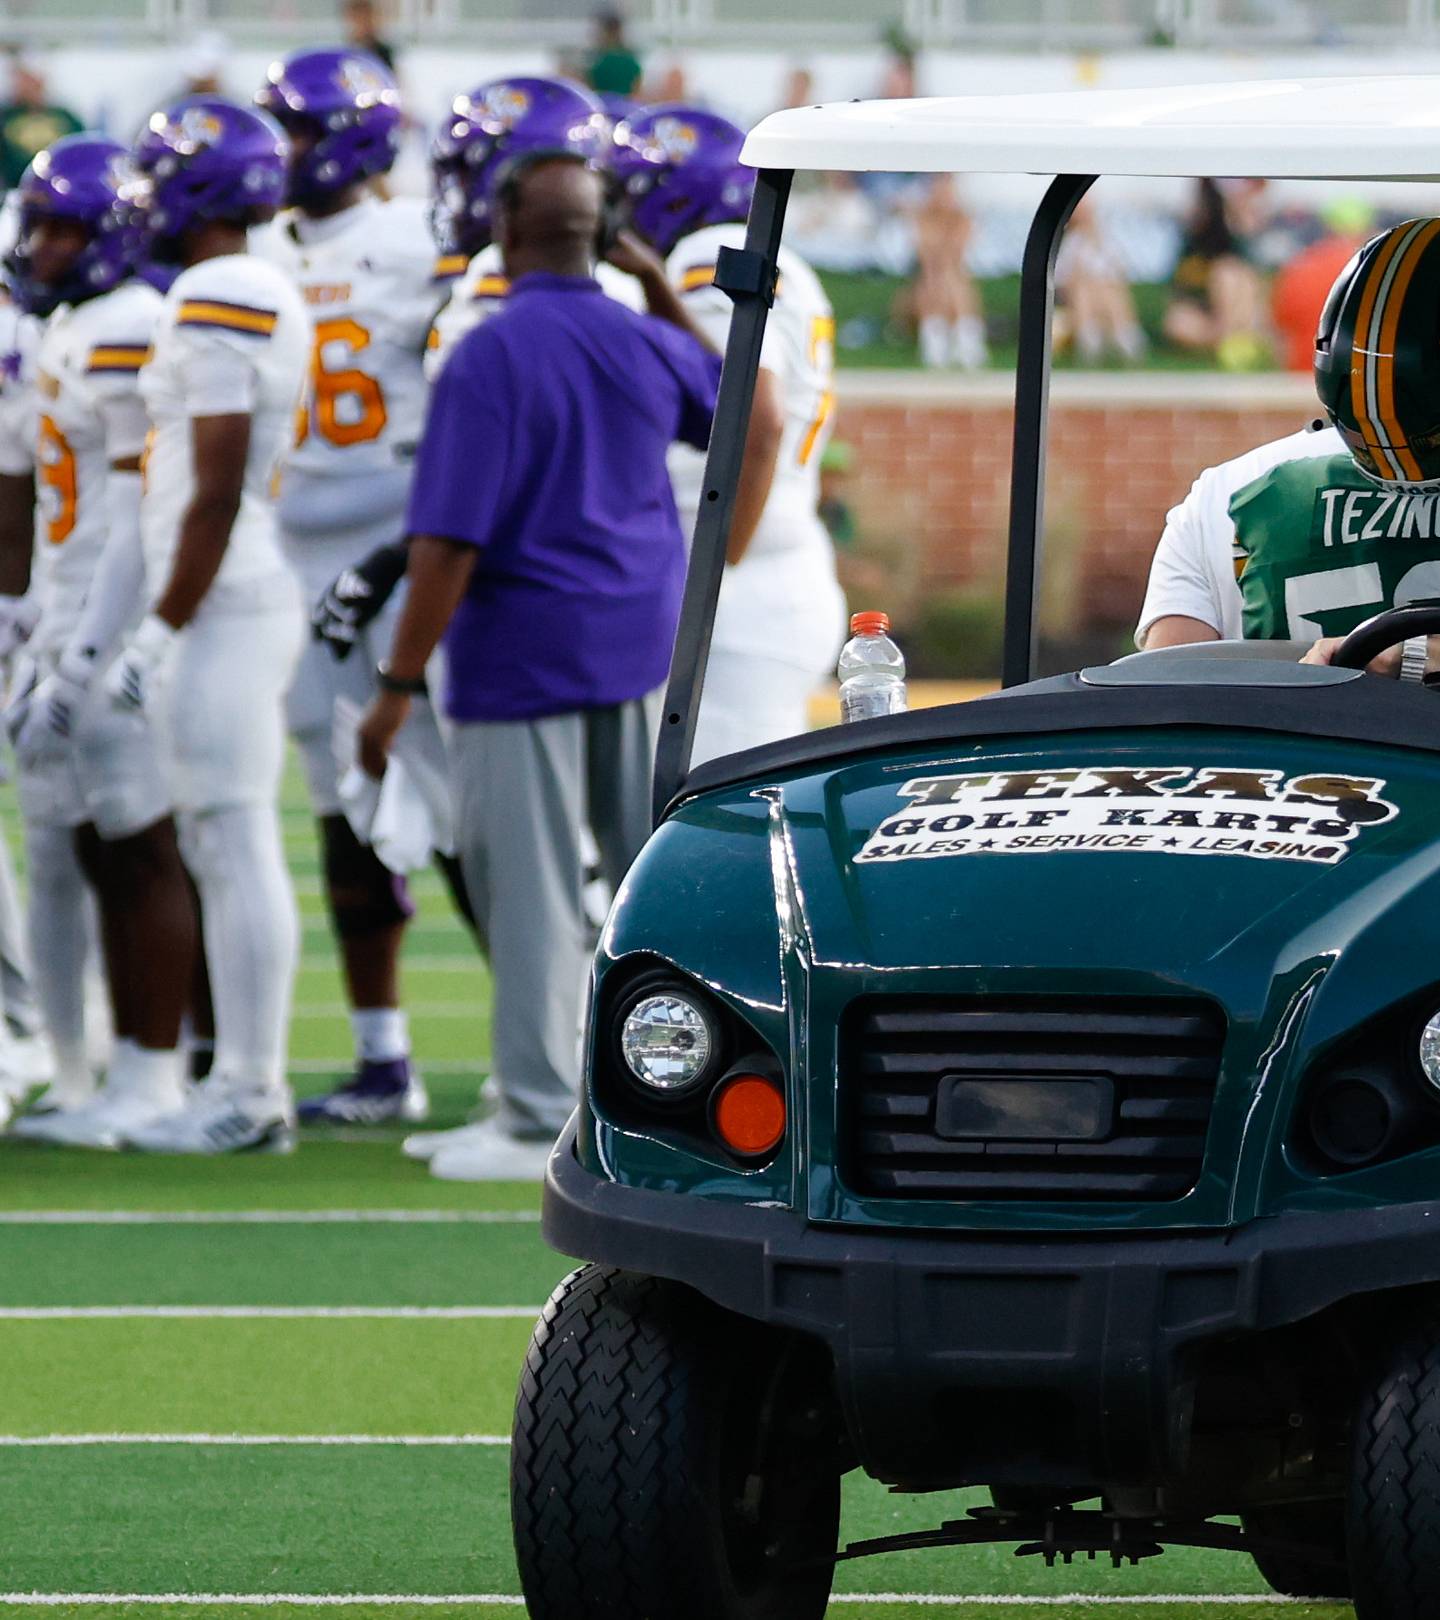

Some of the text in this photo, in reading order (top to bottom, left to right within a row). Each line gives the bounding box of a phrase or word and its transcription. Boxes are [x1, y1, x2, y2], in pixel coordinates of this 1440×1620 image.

[905, 769, 1391, 824] TEXAS
[880, 808, 1352, 839] GOLF KARTS
[863, 834, 1341, 859] SALES SERVICE LEASING
